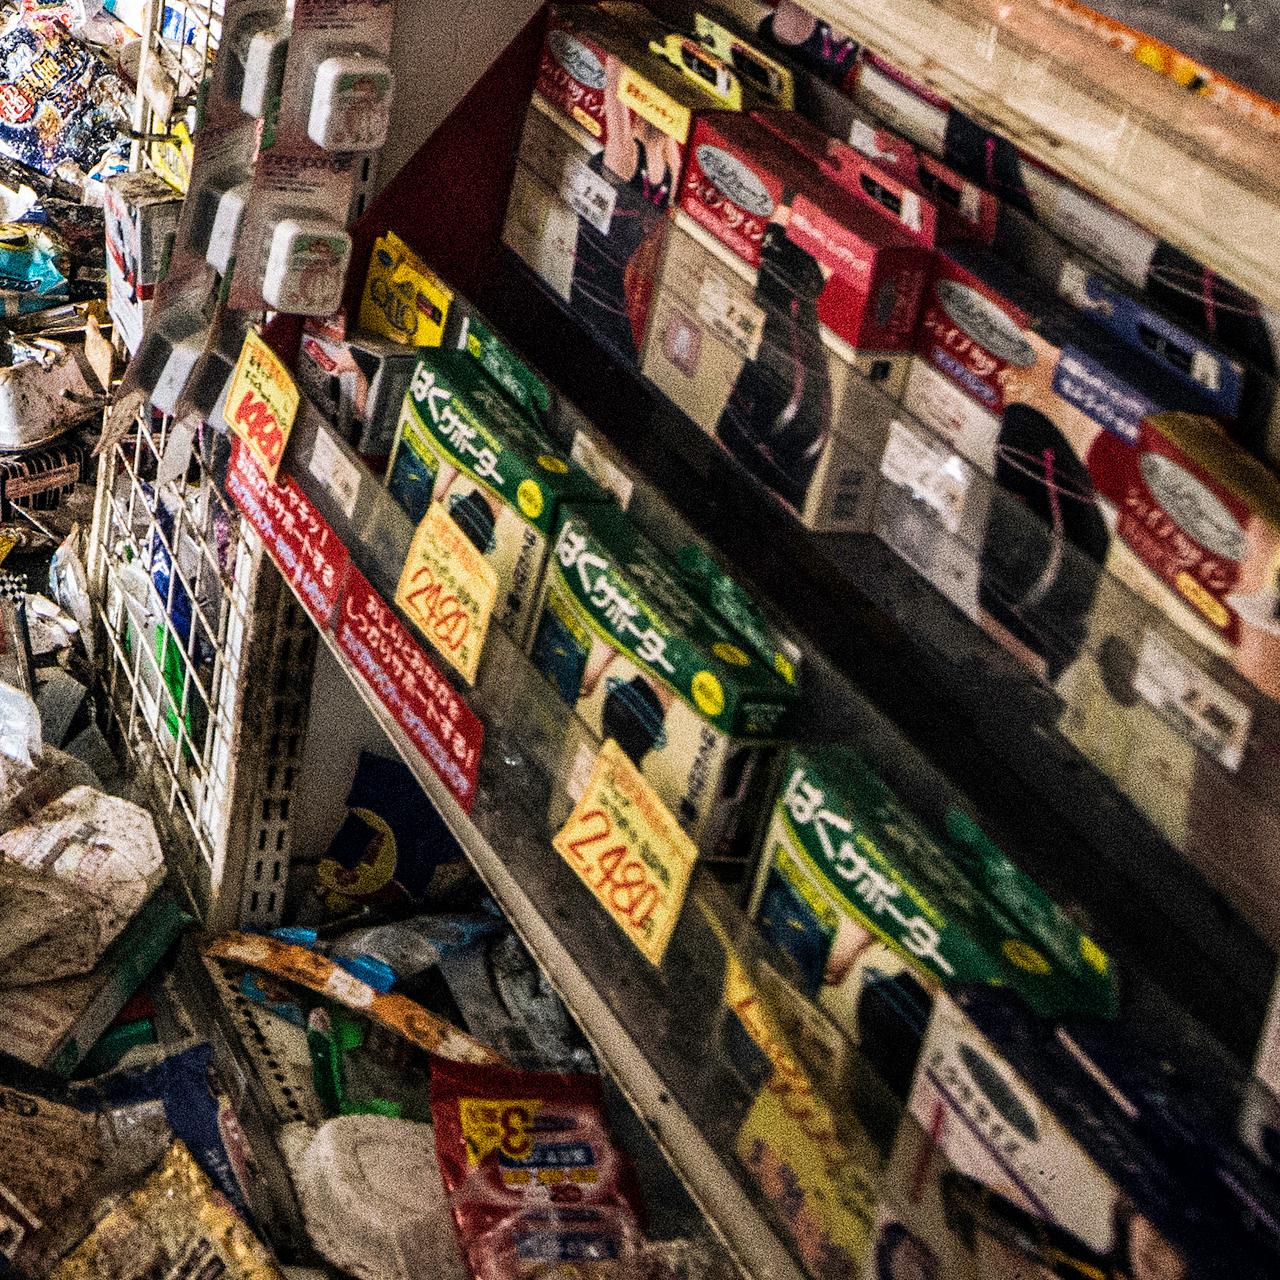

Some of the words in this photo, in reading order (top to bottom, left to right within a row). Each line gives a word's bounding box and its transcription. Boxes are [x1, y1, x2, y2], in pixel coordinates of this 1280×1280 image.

[786, 768, 956, 977] はくサポーター
